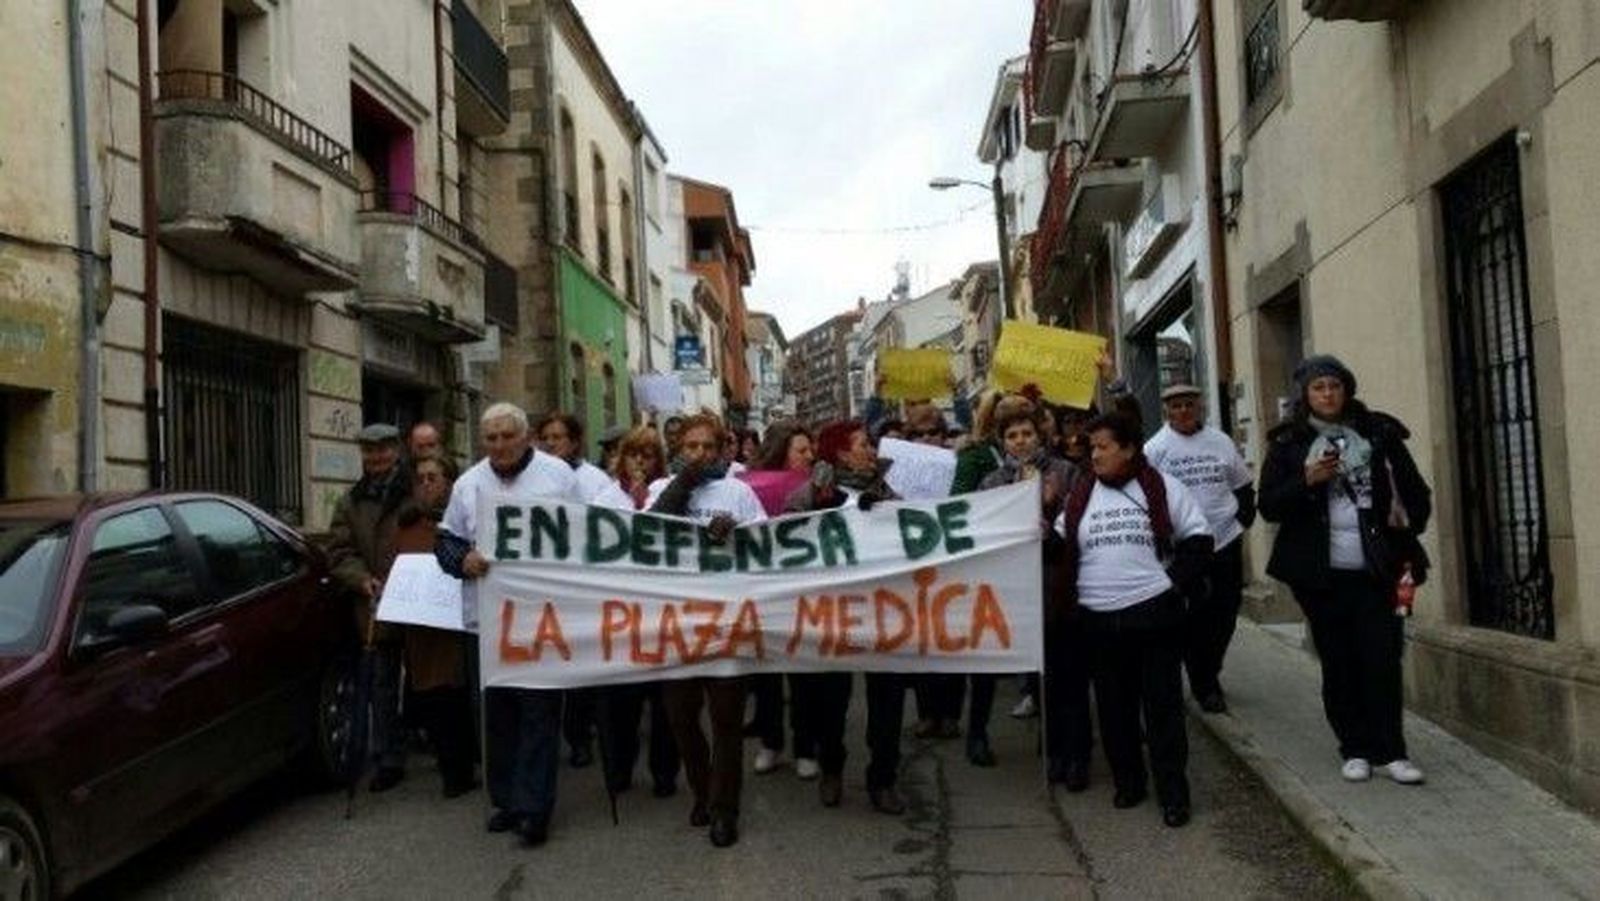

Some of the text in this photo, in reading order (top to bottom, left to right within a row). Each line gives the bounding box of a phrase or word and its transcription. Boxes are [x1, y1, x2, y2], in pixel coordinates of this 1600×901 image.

[495, 500, 976, 572] EN DEFENSA DE
[499, 567, 1012, 666] LA PLAZA MEDICA
